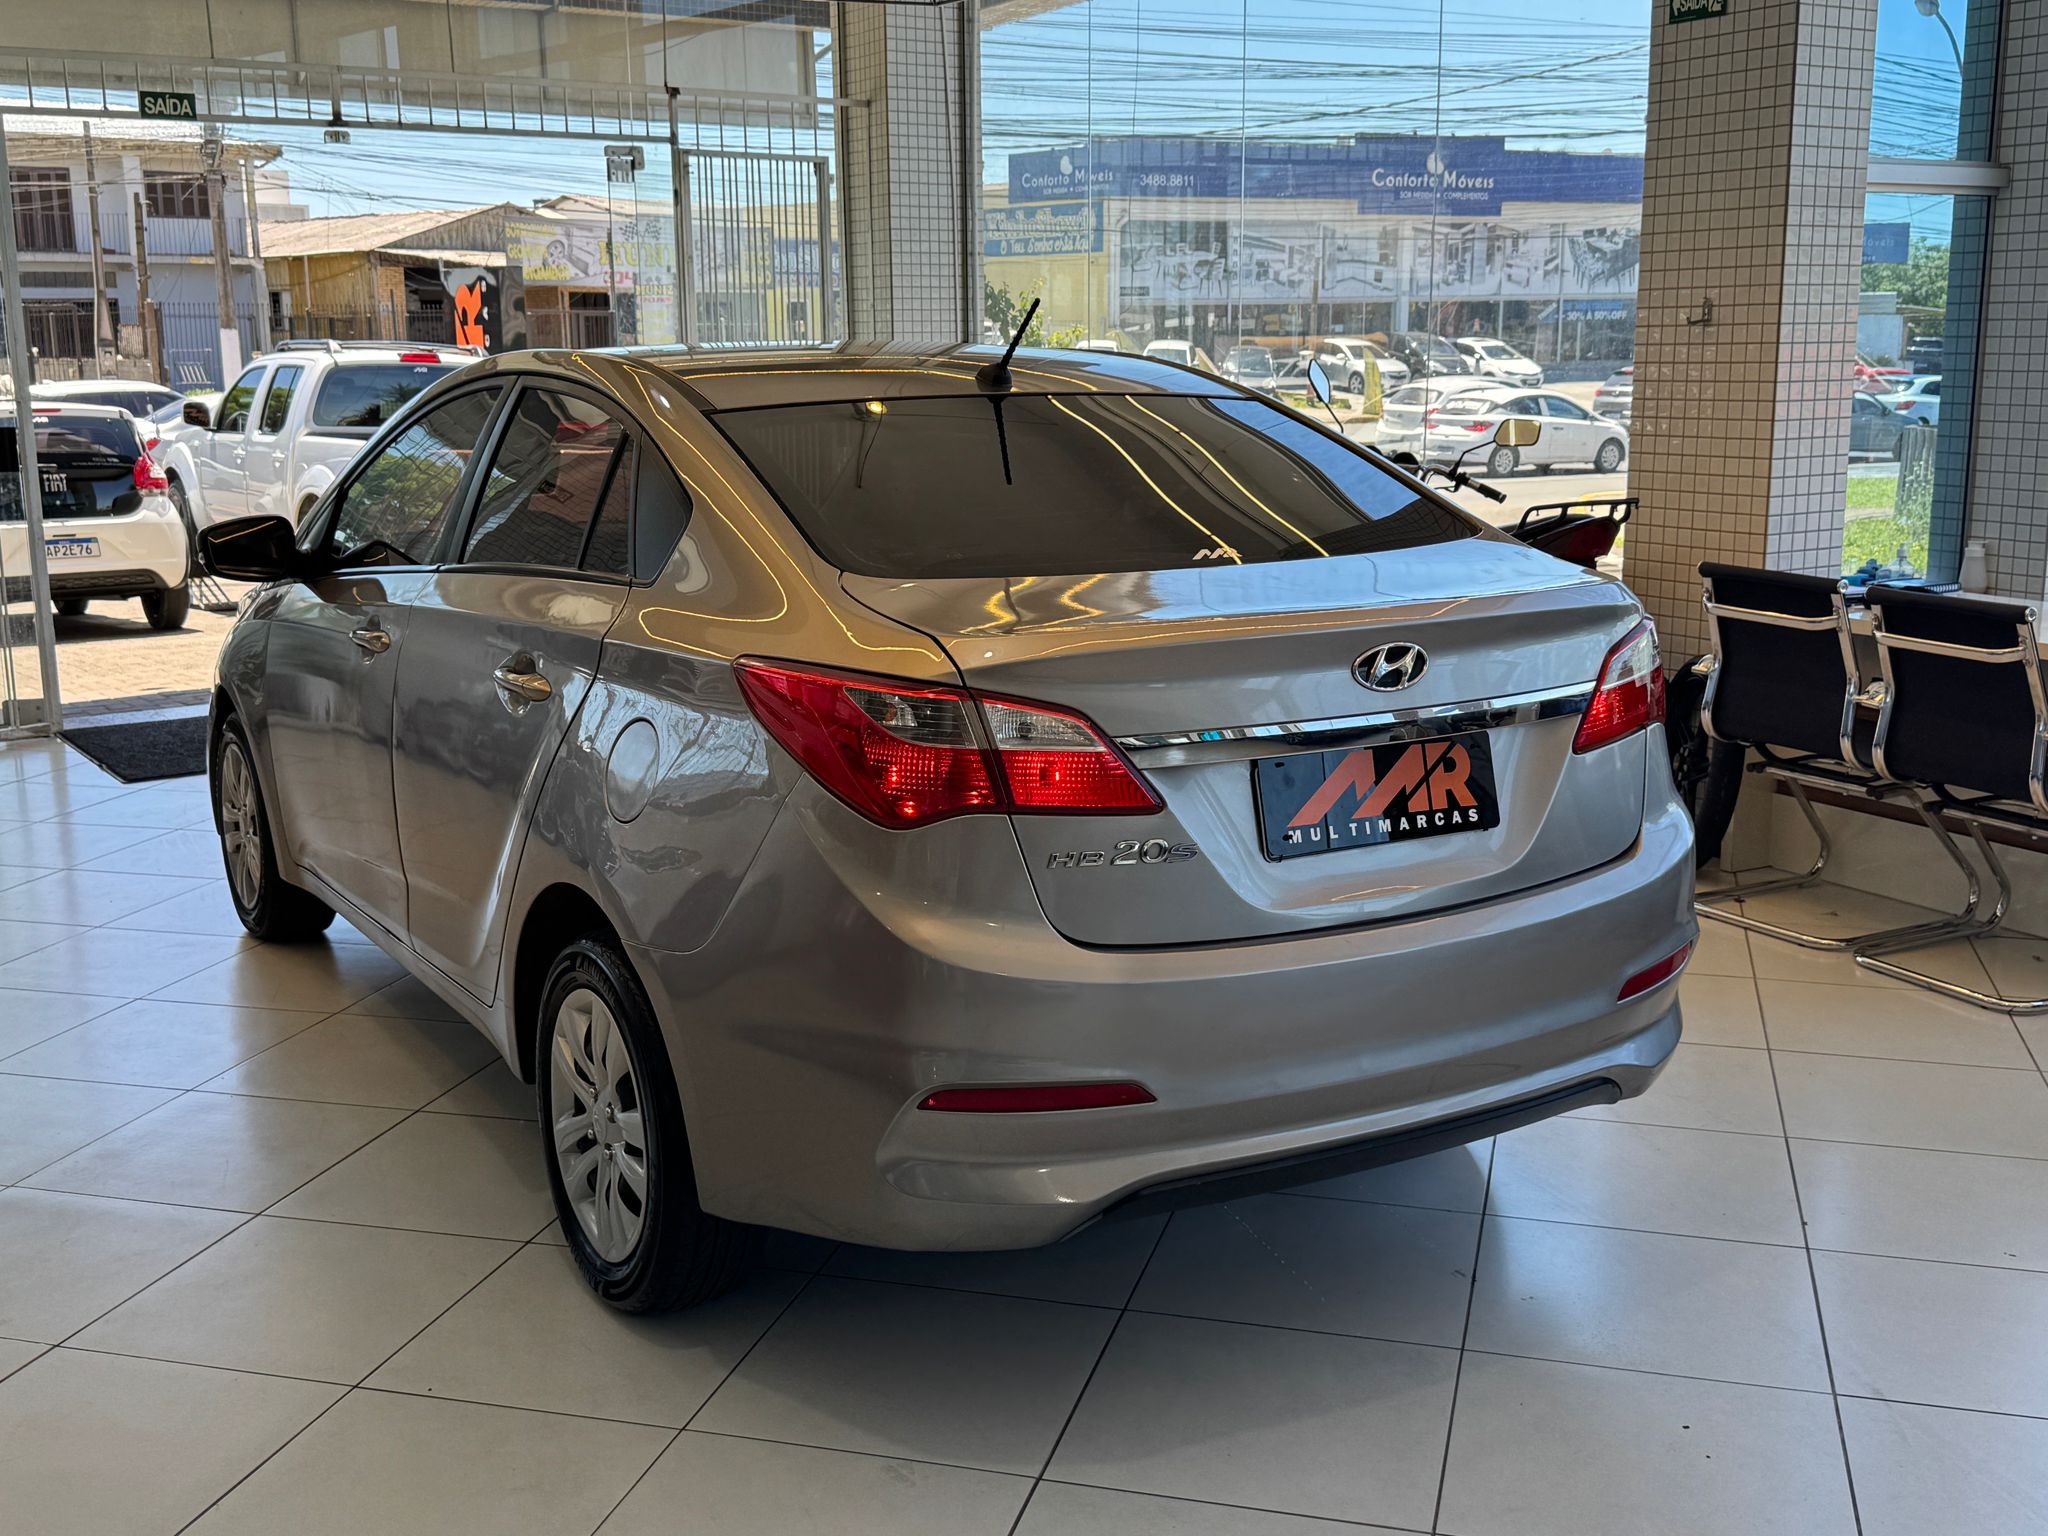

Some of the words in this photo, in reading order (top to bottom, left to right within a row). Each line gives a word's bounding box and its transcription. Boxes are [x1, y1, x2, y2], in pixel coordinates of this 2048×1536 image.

[144, 94, 193, 117] SAÍDA
[1021, 172, 1070, 188] Conforto
[1139, 173, 1195, 188] 3488.8811
[1371, 168, 1438, 188] Conforto
[1442, 169, 1495, 189] Móveis
[43, 473, 67, 492] FIAT
[1288, 808, 1479, 844] MULTIMARCAS
